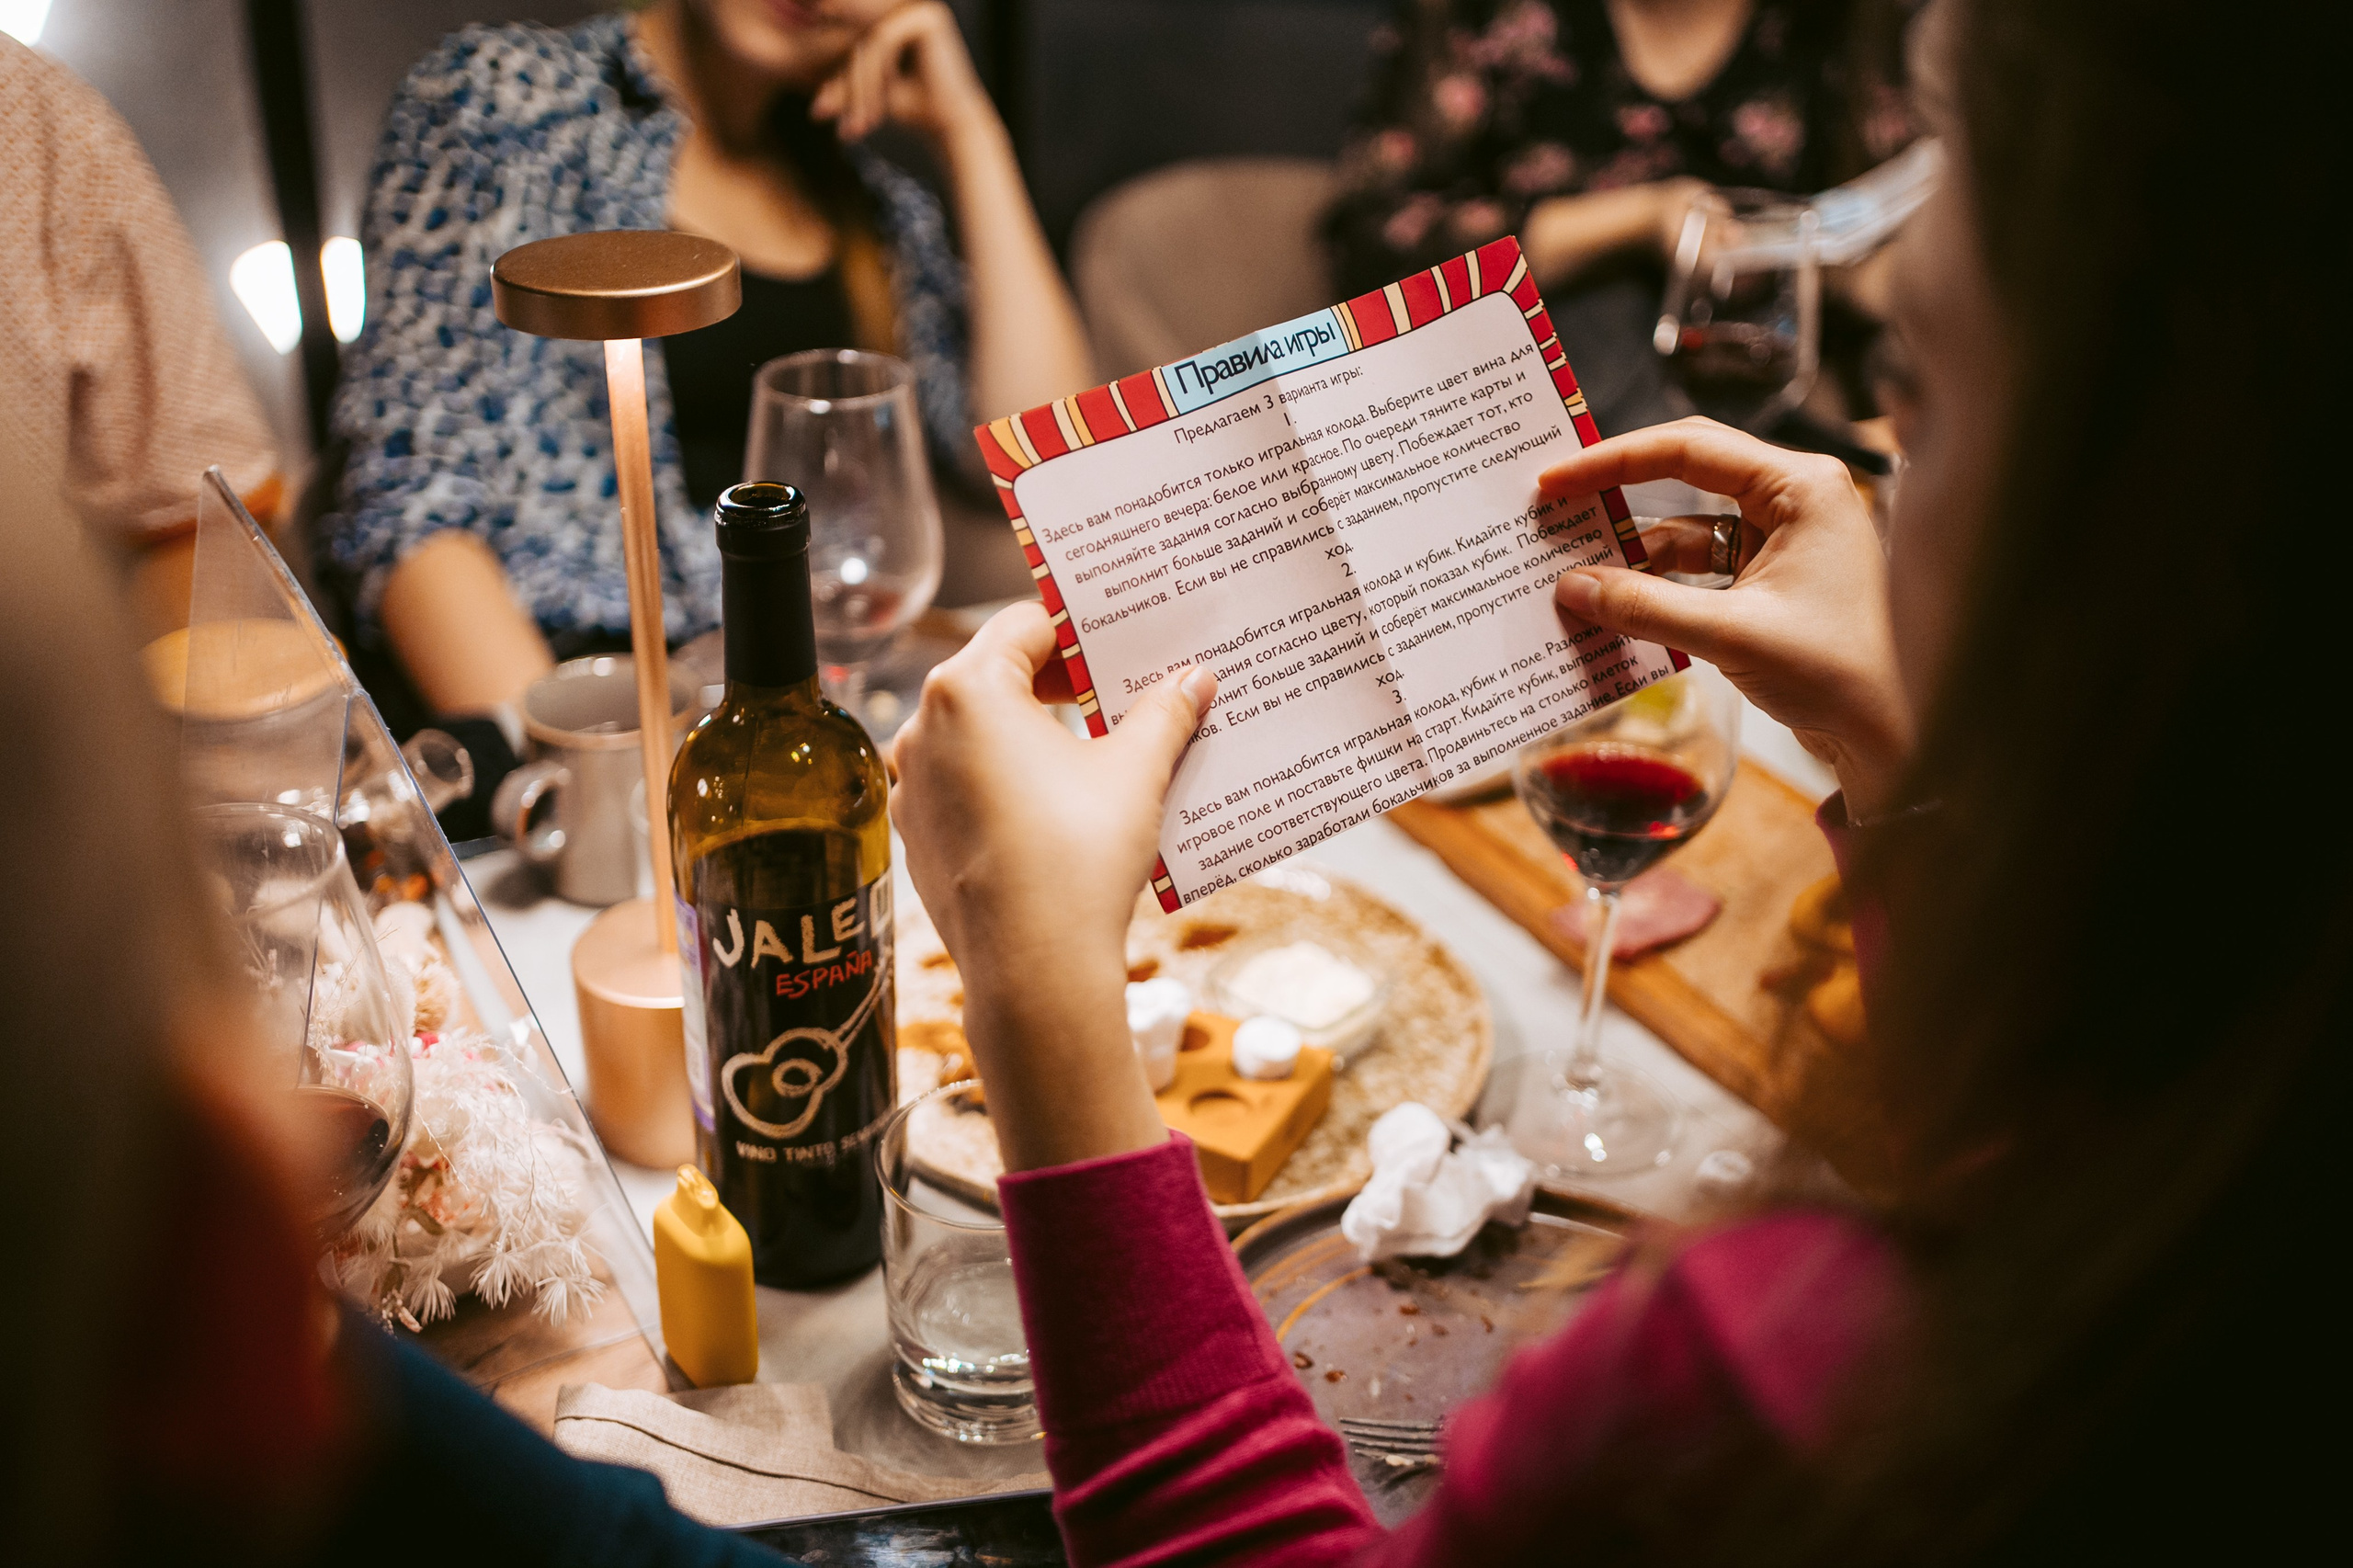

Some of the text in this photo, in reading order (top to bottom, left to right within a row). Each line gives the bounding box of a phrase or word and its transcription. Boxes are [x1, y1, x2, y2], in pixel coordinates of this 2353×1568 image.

[1173, 366, 1363, 444] Предлагаем 3 варианта игры:
[1175, 322, 1336, 395] Правила игры
[1041, 343, 1534, 543] Здесь вам понадобится только игральная колода. Выберите цвет вина для
[1065, 370, 1526, 561] сегодняшнего вечера: белое или красное. По очереди тяните карты и
[1074, 392, 1532, 584] выполняйте задания согласно выбранному цвету. Побеждает тот, кто
[1104, 421, 1520, 597] выполнит больше заданий и соберёт максимальное количество
[1081, 424, 1562, 633] бокальчиков. Если вы не справились с заданием, пропустите следующий
[1122, 671, 1164, 694] Здесь
[1194, 618, 1286, 664] понадобится
[1288, 586, 1361, 624] игральная
[1362, 569, 1402, 593] колода
[1404, 563, 1414, 574] и
[1415, 547, 1455, 571] кубик.
[1454, 521, 1511, 551] Кидайте
[1513, 501, 1554, 528] кубик
[1556, 495, 1567, 507] и
[1251, 660, 1305, 689] больше
[1307, 631, 1366, 666] заданий
[1369, 628, 1380, 641] и
[1381, 606, 1427, 634] соберёт
[1430, 564, 1520, 612] максимальное
[1522, 528, 1602, 570] количество
[1255, 630, 1317, 663] согласно
[1320, 610, 1367, 636] цвету,
[1368, 584, 1417, 616] который
[1419, 564, 1470, 592] показал
[1471, 545, 1512, 570] кубик.
[1516, 506, 1596, 549] Побеждает
[1324, 541, 1354, 560] ход.
[1340, 562, 1356, 577] 2.
[1225, 705, 1259, 726] Если
[1262, 695, 1281, 711] вы
[1284, 687, 1302, 701] не
[1305, 652, 1385, 692] справились
[1387, 646, 1394, 656] с
[1395, 619, 1456, 653] заданием,
[1455, 585, 1530, 625] пропустите
[1374, 669, 1404, 687] ход.
[1392, 688, 1406, 704] 3.
[1176, 633, 1638, 853] игровое поле и поставьте фишки на старт. Кидайте кубик, выполняйт
[1178, 801, 1222, 824] Здесь
[1223, 787, 1250, 805] вам
[1252, 744, 1340, 792] понадобится
[1343, 712, 1412, 751] игральная
[1413, 692, 1460, 719] колода,
[1460, 672, 1497, 698] кубик
[1498, 667, 1508, 678] и
[1510, 652, 1545, 673] поле.
[1182, 665, 1668, 904] вперёд, сколько заработали бокальчиков за выполненное задание. Если вы
[1198, 655, 1638, 870] задание соответствующего цвета. Продвиньтесь на столько клеток
[776, 949, 872, 1000] ESPAÑA
[735, 1140, 778, 1163] VINO
